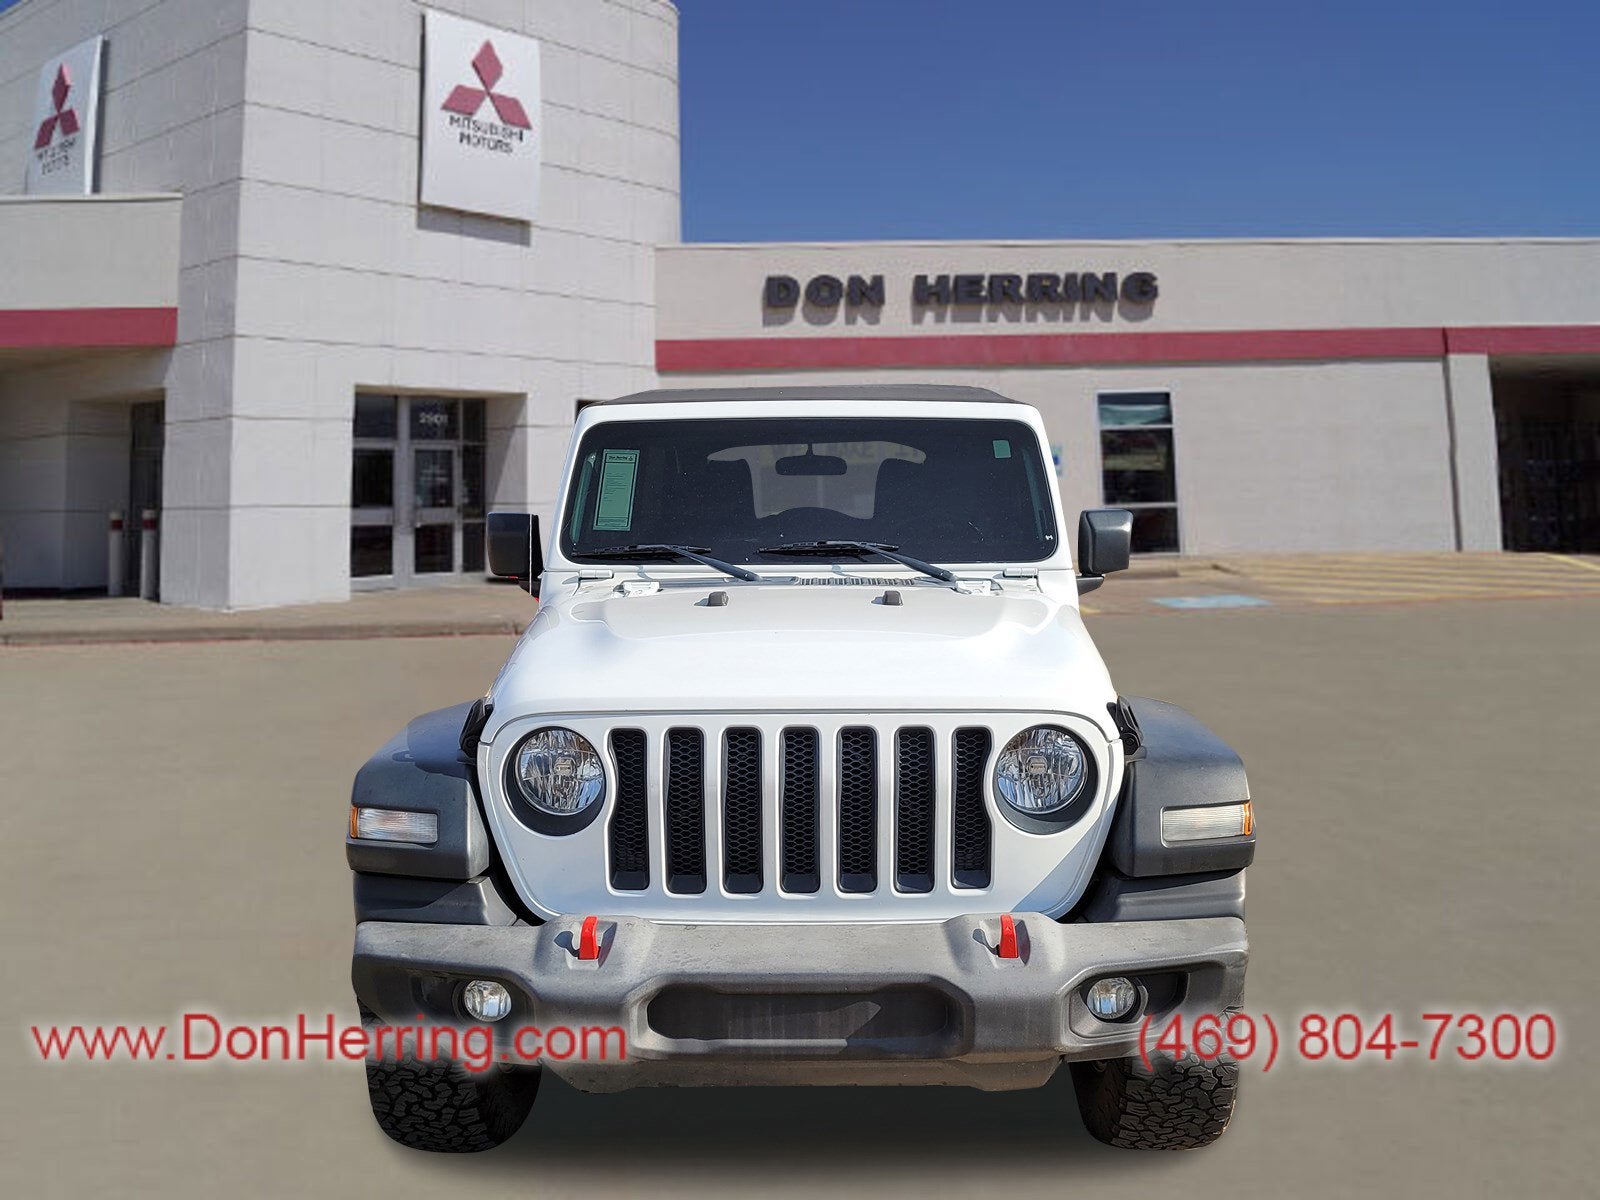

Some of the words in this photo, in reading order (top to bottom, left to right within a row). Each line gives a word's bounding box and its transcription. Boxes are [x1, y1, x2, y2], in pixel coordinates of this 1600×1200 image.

[460, 132, 513, 153] MOTORS
[765, 274, 885, 306] DON
[912, 272, 1159, 305] HERRING
